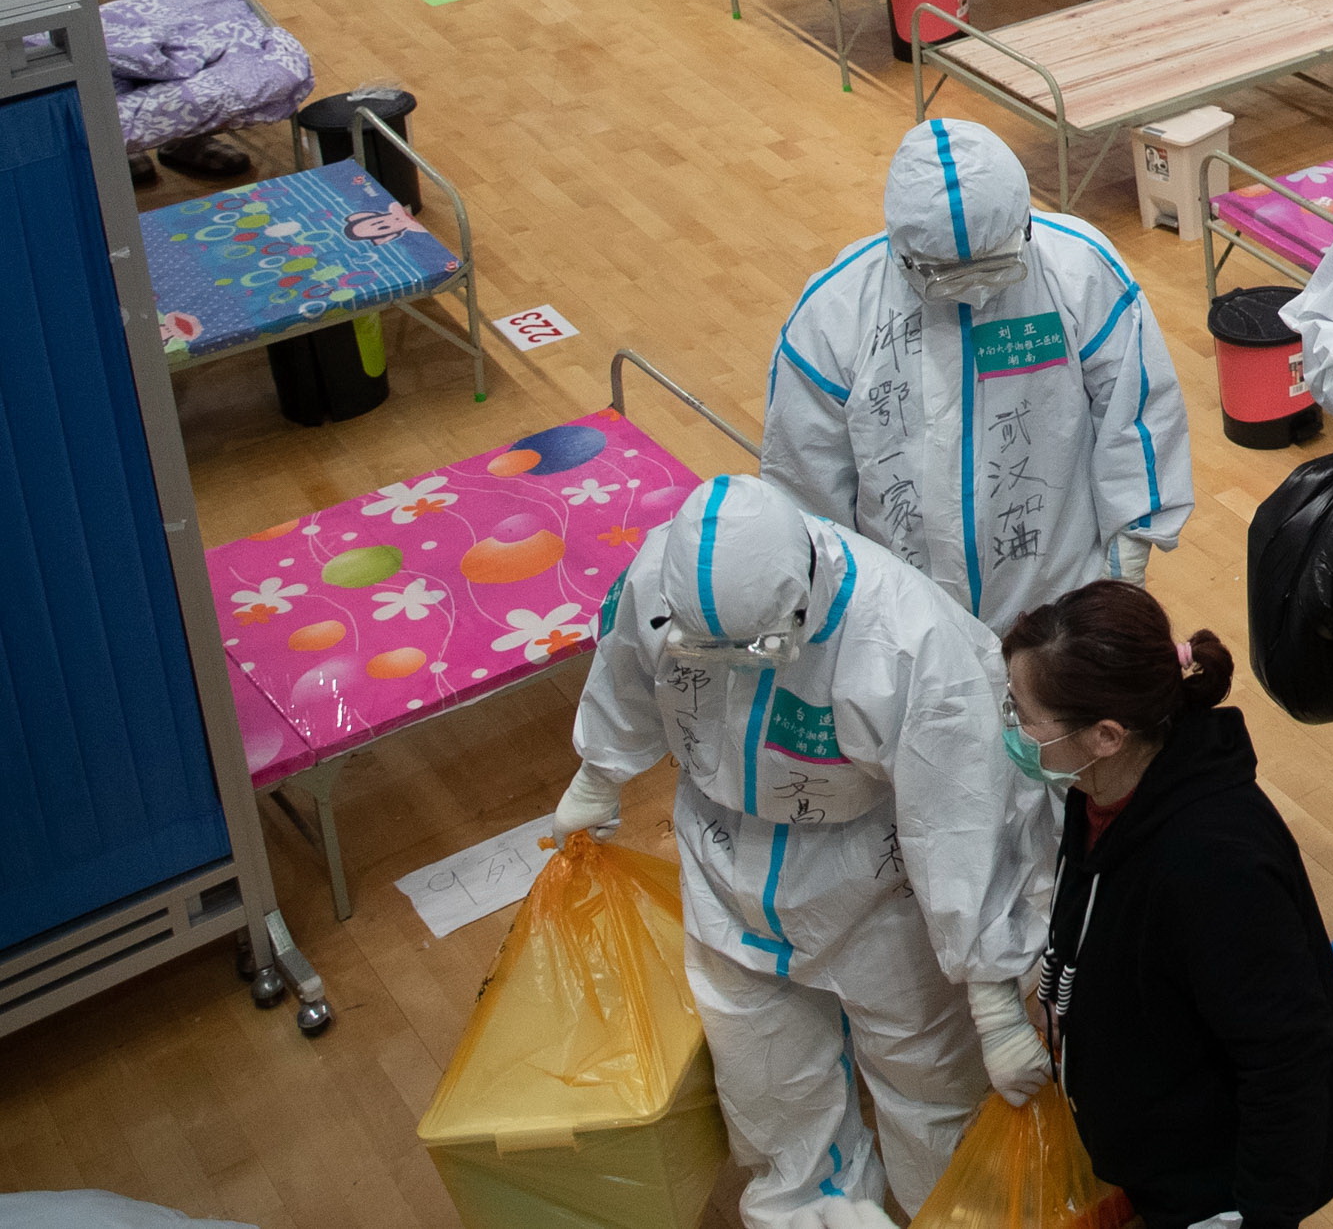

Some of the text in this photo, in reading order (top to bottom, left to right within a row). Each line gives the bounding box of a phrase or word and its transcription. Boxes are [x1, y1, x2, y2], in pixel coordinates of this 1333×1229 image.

[510, 312, 564, 344] 223
[977, 332, 1063, 358] 中南大学湘雅二医院
[1007, 352, 1036, 366] 湖南
[796, 741, 828, 756] 湖南
